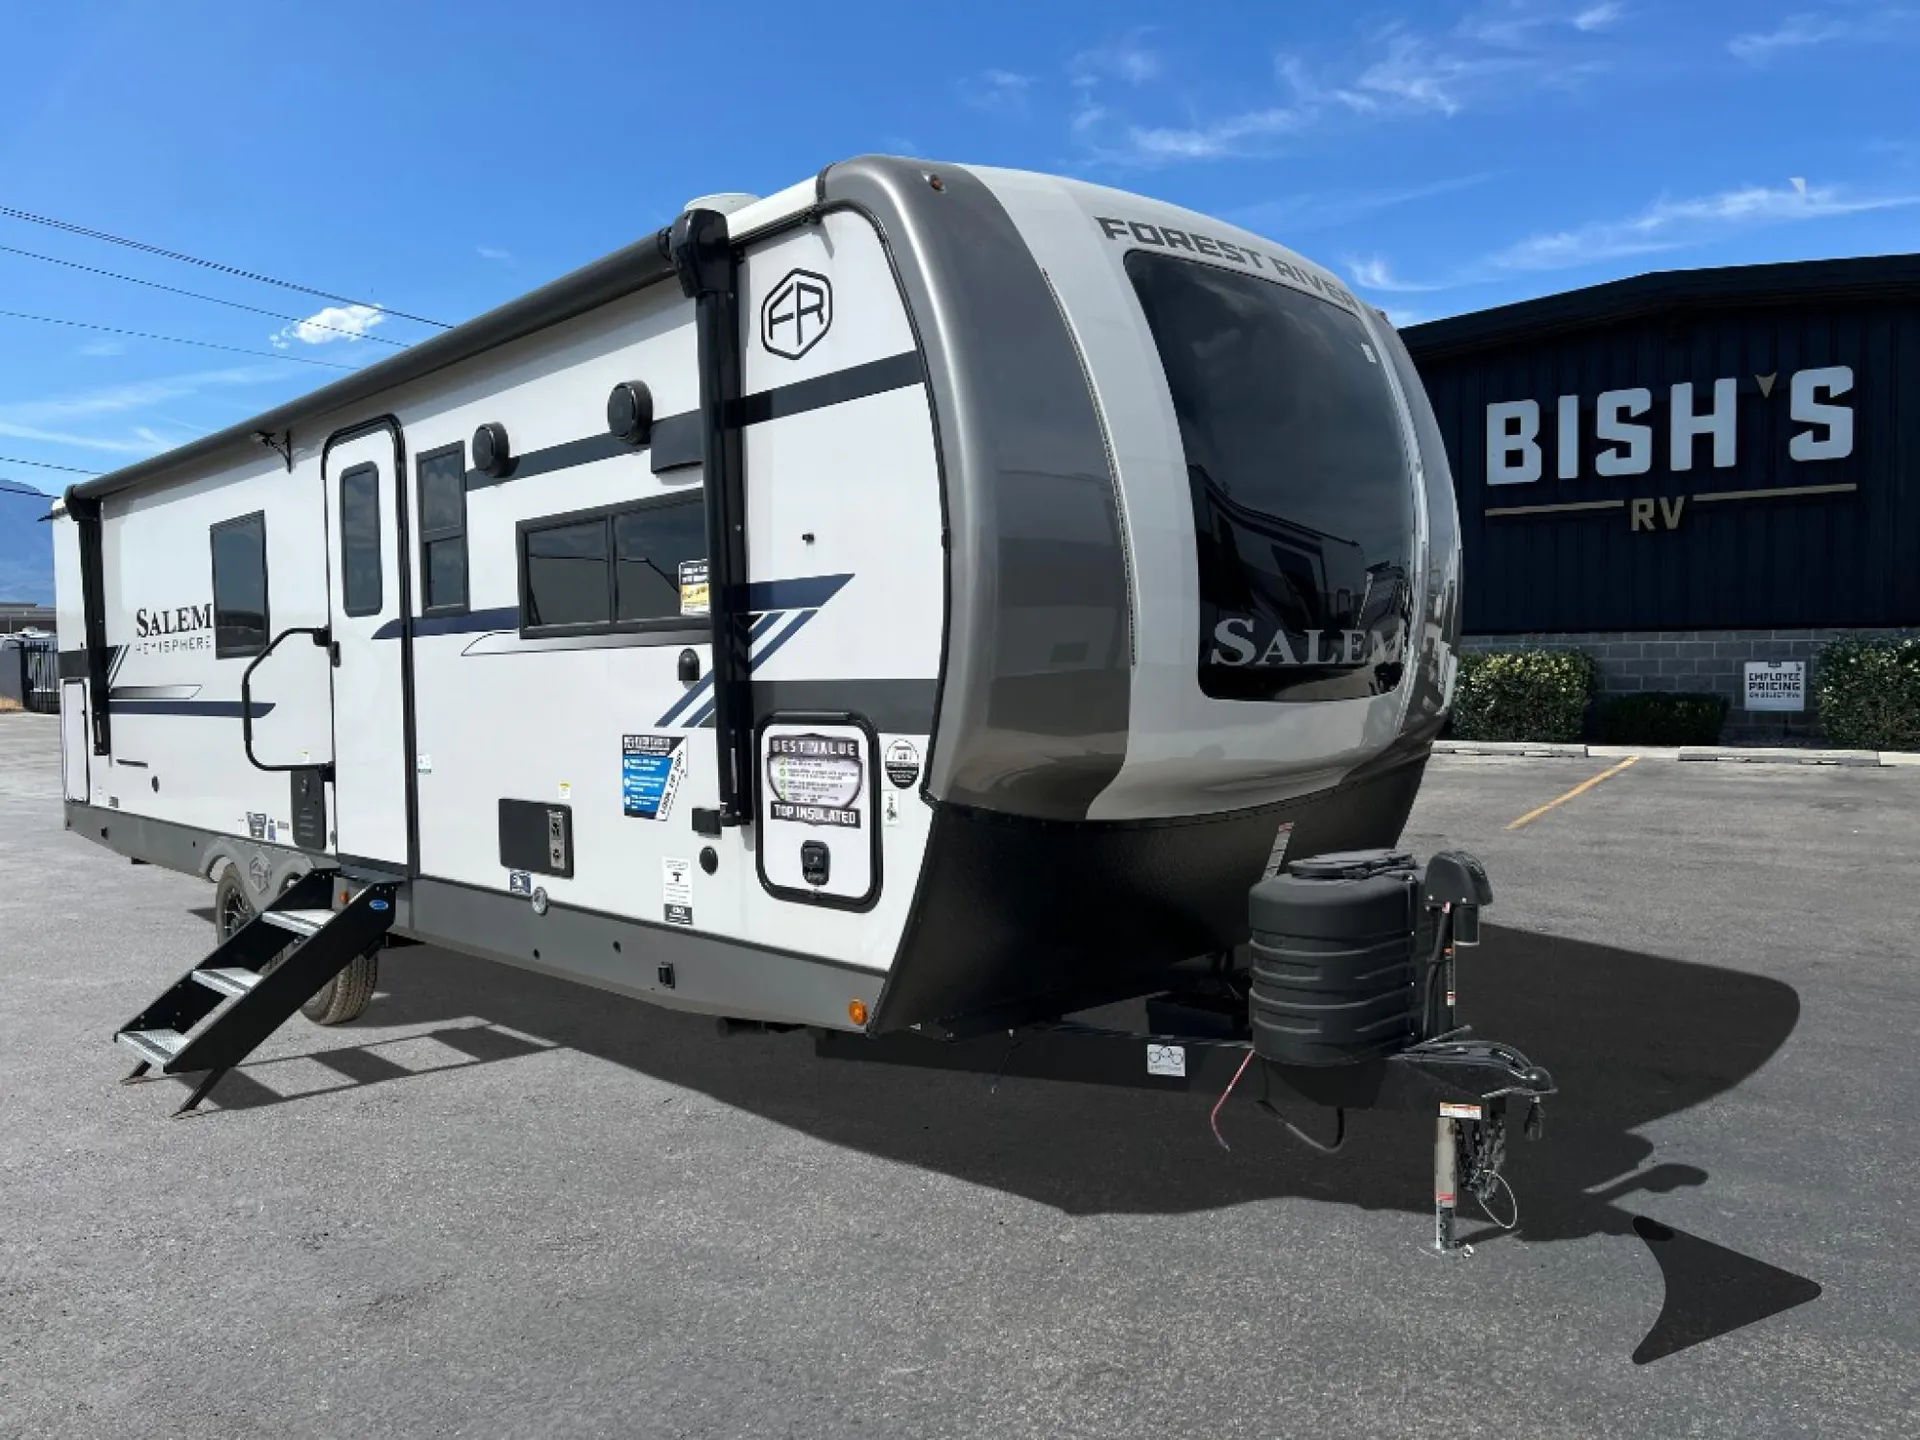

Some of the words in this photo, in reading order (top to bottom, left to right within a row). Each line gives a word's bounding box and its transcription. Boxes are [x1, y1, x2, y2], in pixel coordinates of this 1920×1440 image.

[1094, 216, 1264, 268] FOREST
[1268, 256, 1360, 312] RIVER
[1486, 365, 1855, 486] BISH'S
[1630, 496, 1685, 532] RV
[136, 603, 213, 638] SALEM
[1210, 617, 1405, 667] SALEM
[1748, 682, 1801, 691] PRICING
[772, 740, 805, 753] BEST
[810, 741, 857, 756] VALUE
[774, 804, 794, 818] TOP
